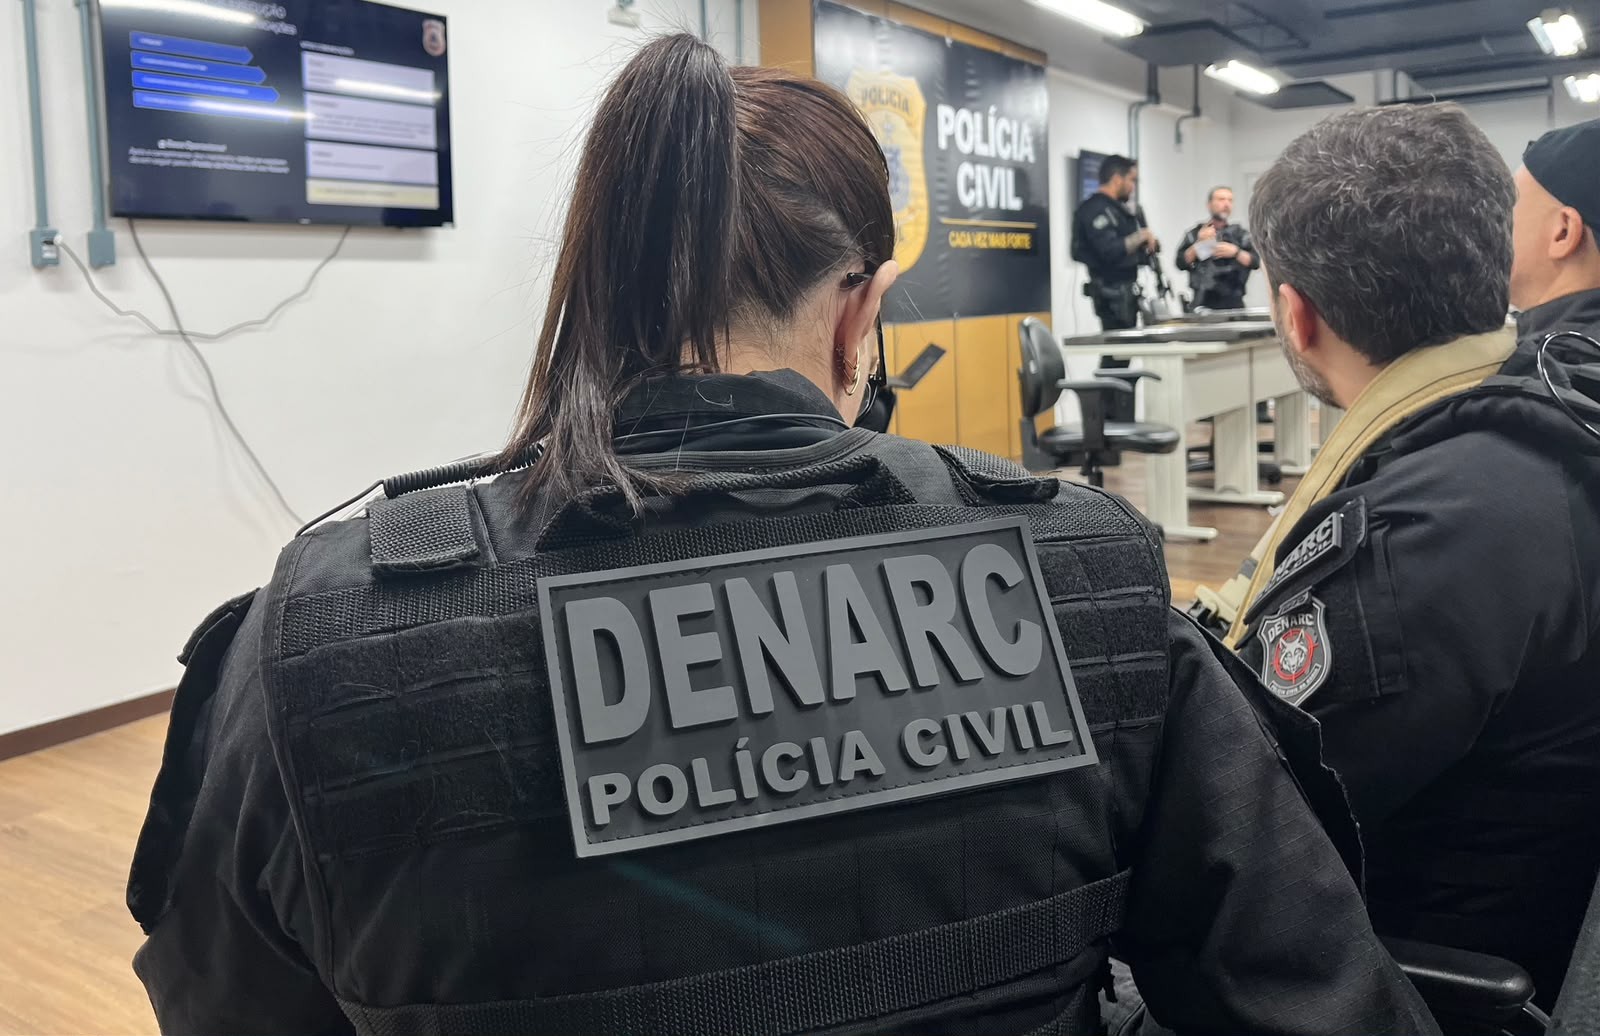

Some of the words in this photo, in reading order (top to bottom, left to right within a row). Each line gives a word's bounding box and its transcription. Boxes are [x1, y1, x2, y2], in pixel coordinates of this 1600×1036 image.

[936, 103, 1035, 163] POLÍCIA
[956, 161, 1023, 210] CIVIL
[949, 231, 973, 248] CADA
[974, 231, 989, 249] VEZ
[990, 232, 1007, 249] MAIS
[1008, 232, 1032, 250] FORTE
[1272, 519, 1332, 580] NARC
[565, 543, 1043, 744] DENARC
[1267, 613, 1314, 642] DENARC
[588, 729, 887, 825] POLÍCIA
[903, 701, 1074, 768] CIVIL
